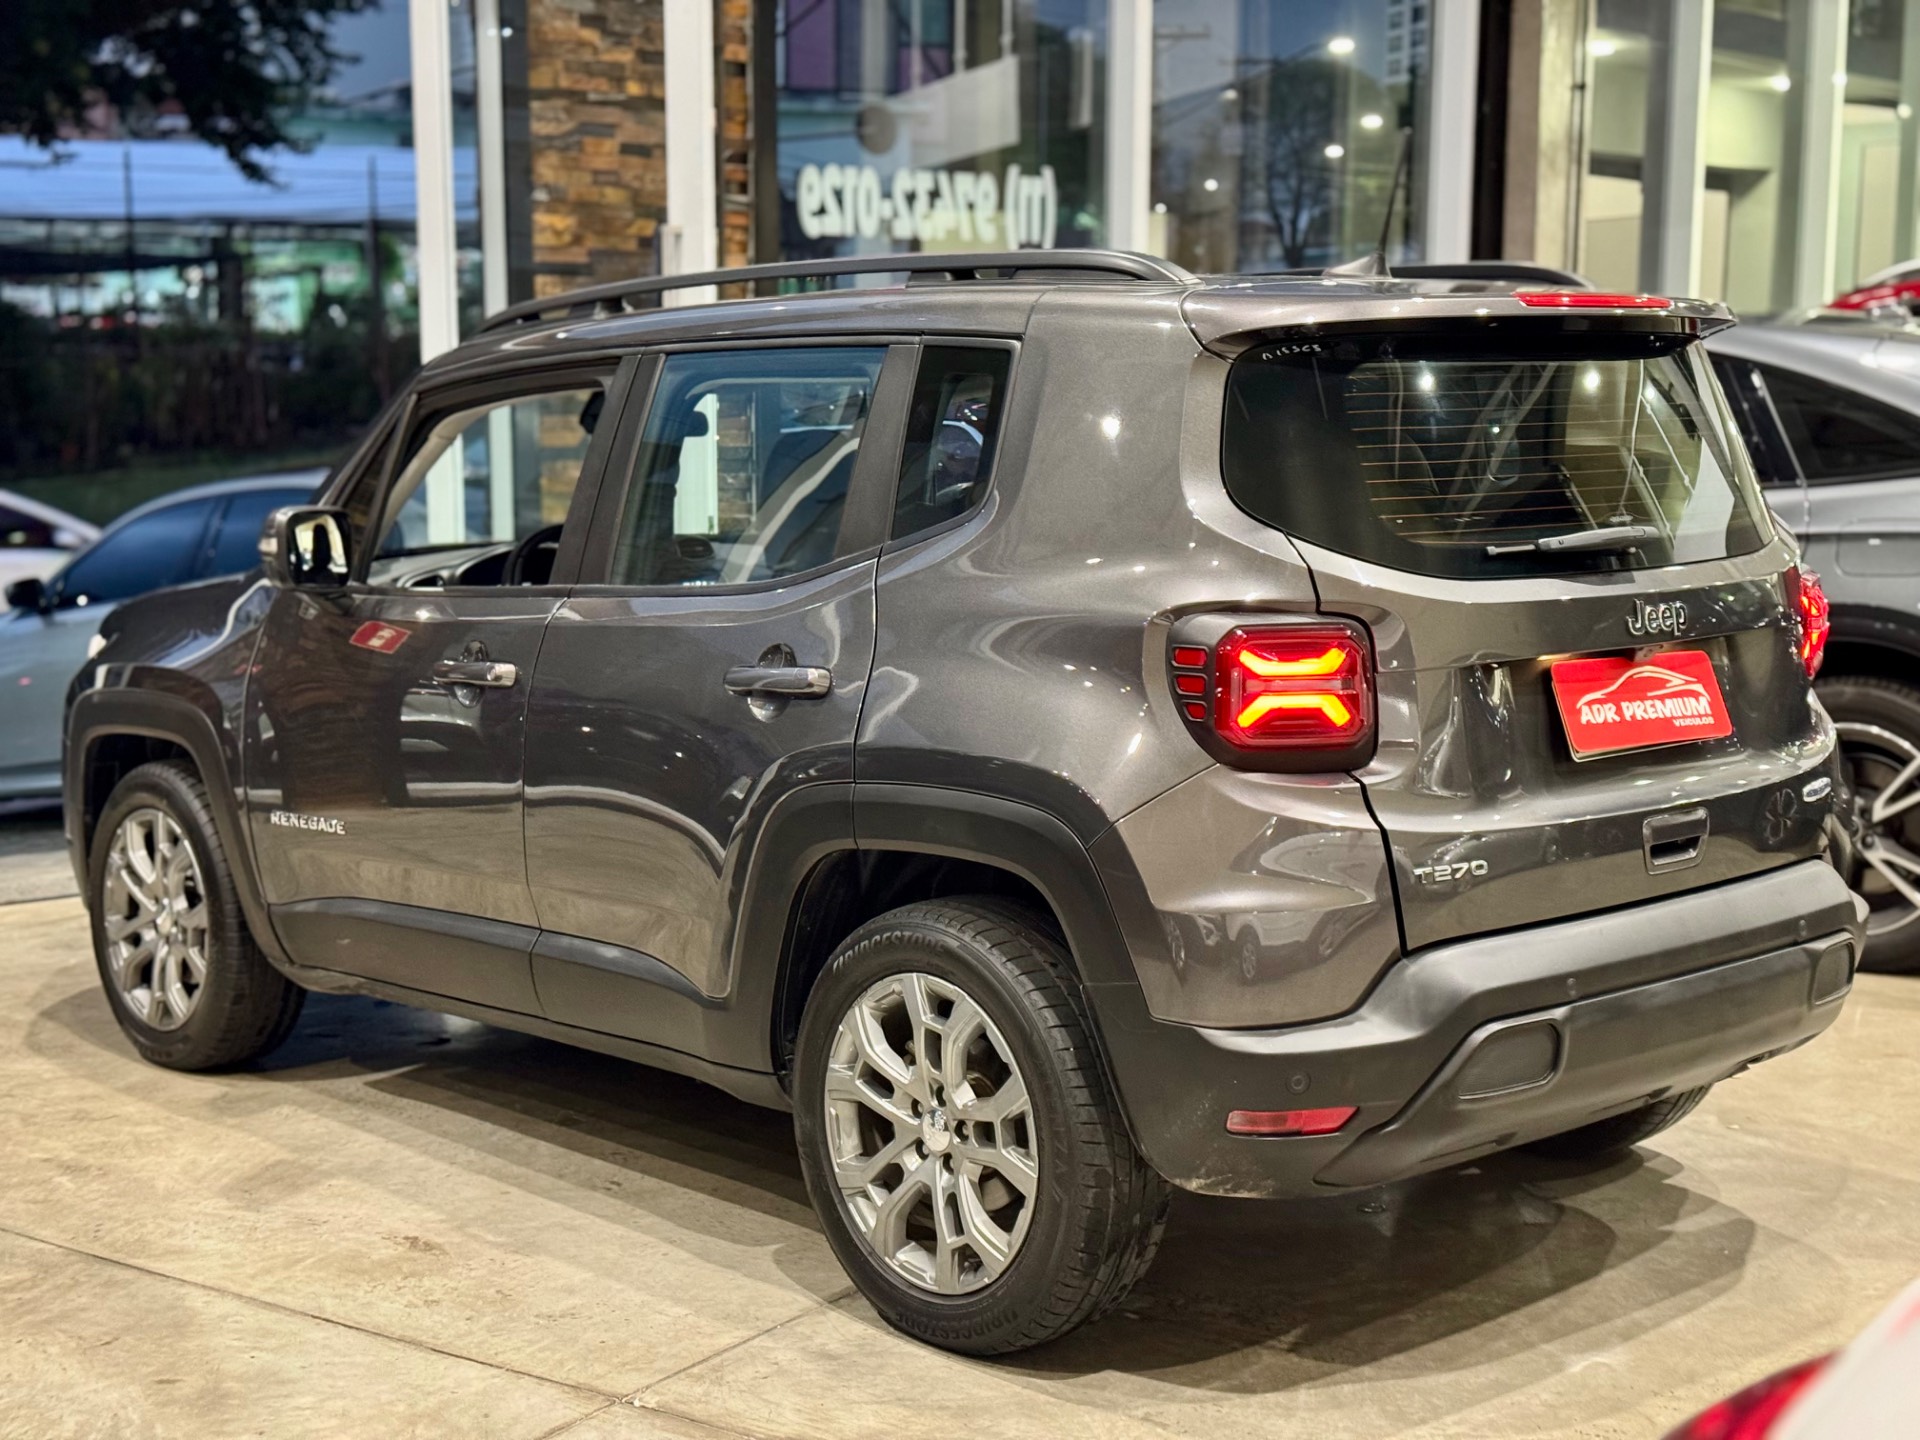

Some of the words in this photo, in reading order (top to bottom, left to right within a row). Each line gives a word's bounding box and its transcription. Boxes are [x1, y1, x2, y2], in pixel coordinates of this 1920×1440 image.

[1626, 598, 1688, 636] Jeep
[1580, 702, 1621, 724] ADR
[1621, 697, 1712, 720] PREMIUM
[270, 810, 346, 835] RENEGADE
[1413, 859, 1489, 884] T270
